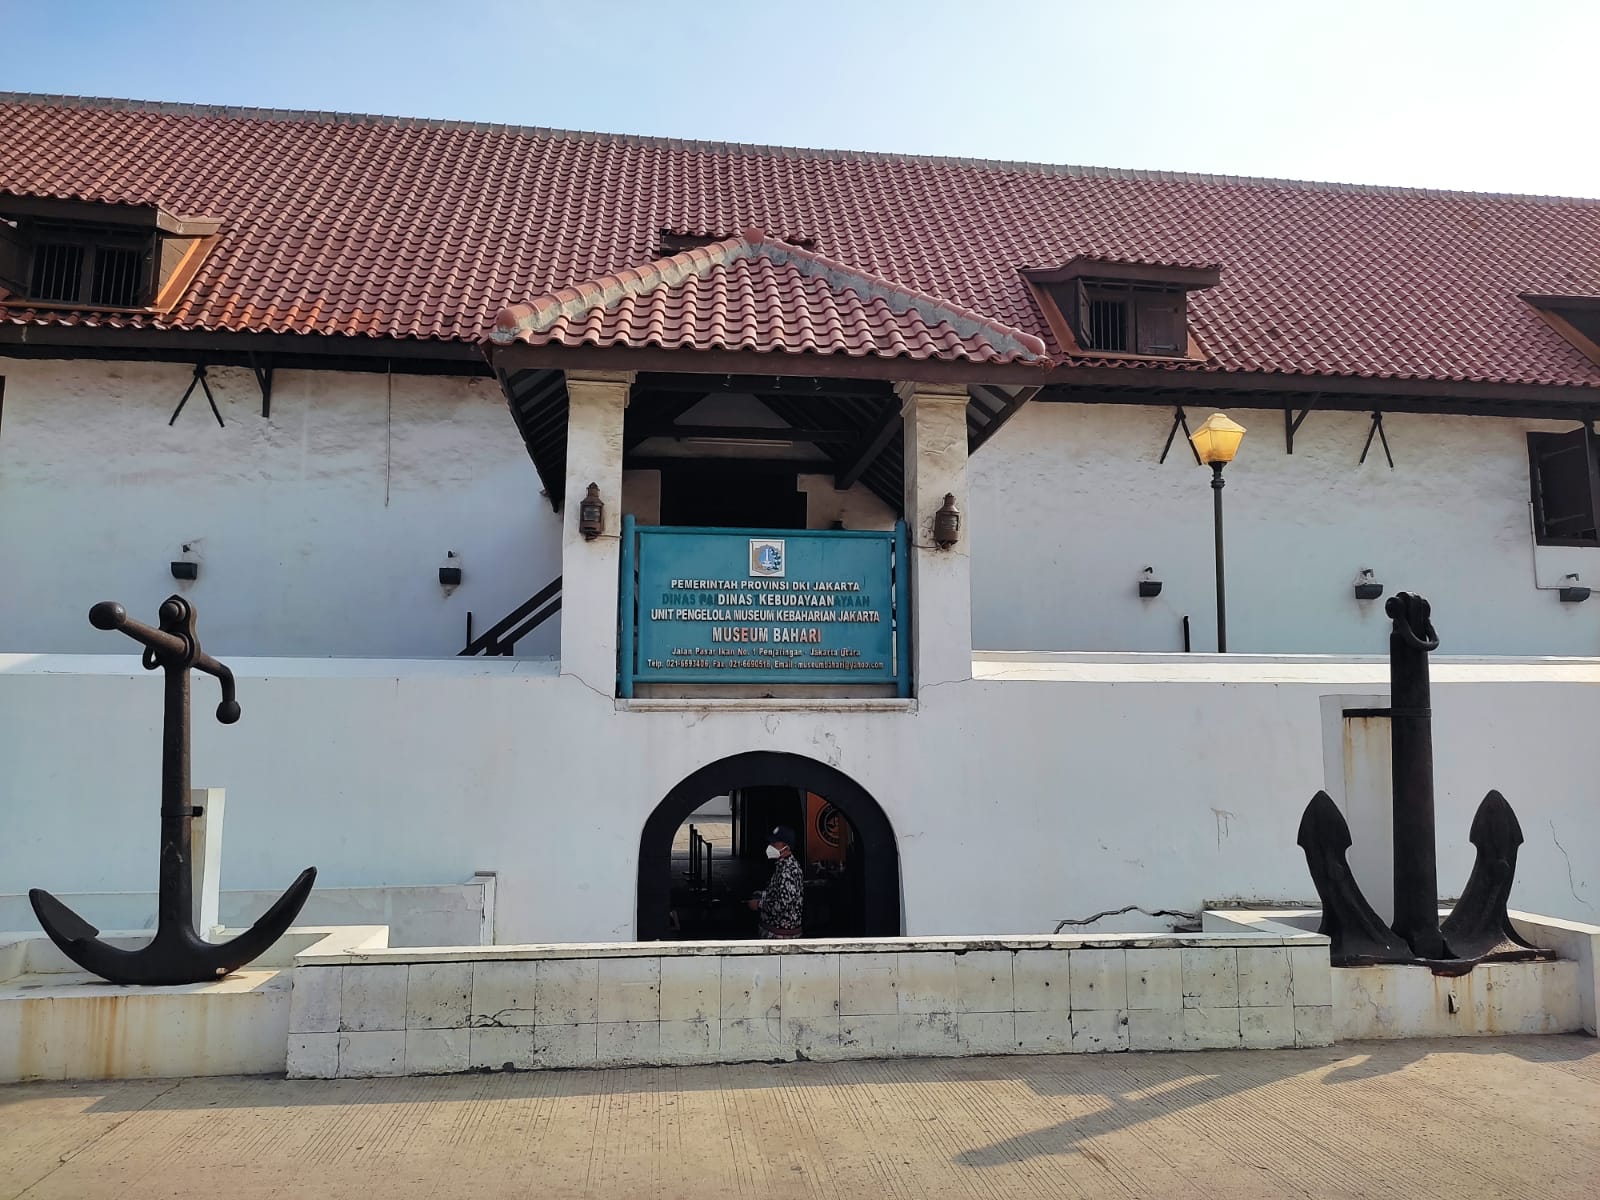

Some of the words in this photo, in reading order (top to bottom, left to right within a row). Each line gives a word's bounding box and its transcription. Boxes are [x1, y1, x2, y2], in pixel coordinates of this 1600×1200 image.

[671, 579, 738, 590] PEMERINTAH
[741, 580, 789, 591] PROVINSI
[792, 581, 810, 591] DKI
[813, 581, 860, 591] JAKARTA
[718, 593, 753, 606] DINAS
[759, 594, 834, 606] KEBUDAYAAN
[651, 608, 673, 620] UNIT
[676, 609, 731, 621] PENGELOLA
[734, 609, 774, 622] MUSEUM
[776, 610, 836, 622] KEBAHARIAN
[838, 610, 880, 622] JAKARTA
[712, 627, 768, 642] MUSEUM
[773, 628, 821, 643] BAHARI
[672, 648, 693, 656] Jalan
[718, 648, 735, 656] Ikan
[737, 648, 750, 656] No.
[752, 648, 756, 656] 1
[758, 648, 802, 658] Penjaringan
[810, 648, 838, 657] Jakarta
[840, 647, 861, 657] Utara
[647, 658, 664, 669] Telp.
[774, 660, 793, 669] Email
